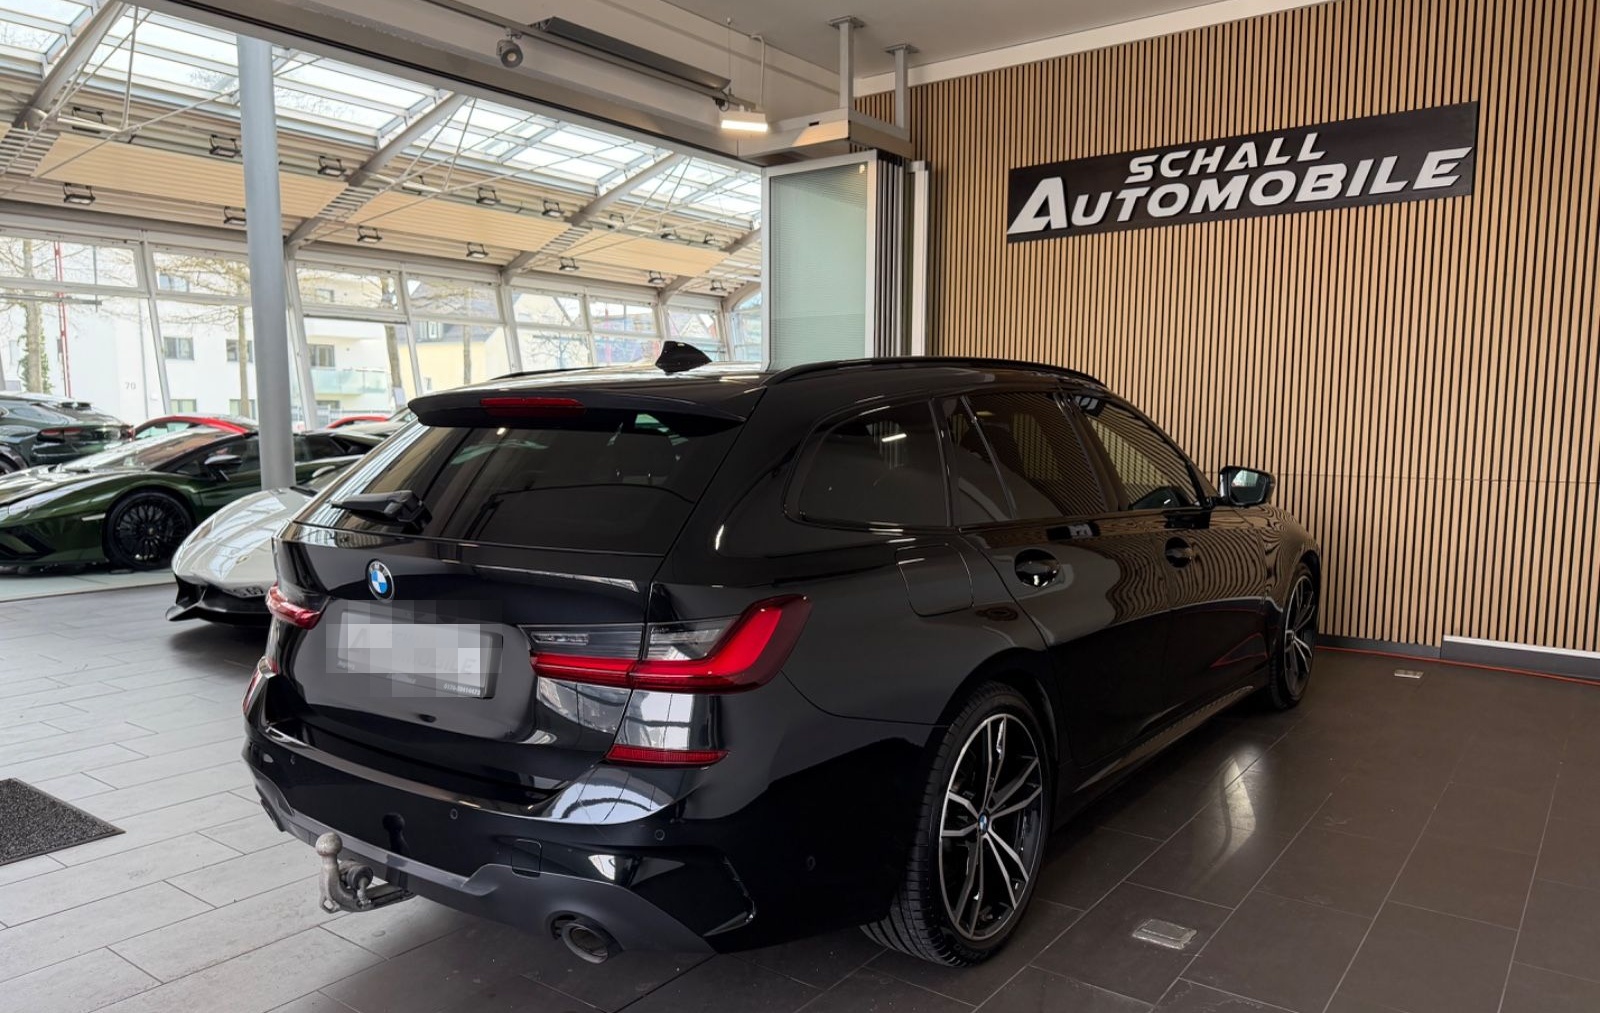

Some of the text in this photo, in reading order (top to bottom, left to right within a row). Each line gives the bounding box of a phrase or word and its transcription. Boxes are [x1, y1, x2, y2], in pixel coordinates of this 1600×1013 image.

[1124, 131, 1326, 184] SCHALL
[1006, 146, 1473, 236] AUTOMOBILE
[125, 381, 137, 390] 70
